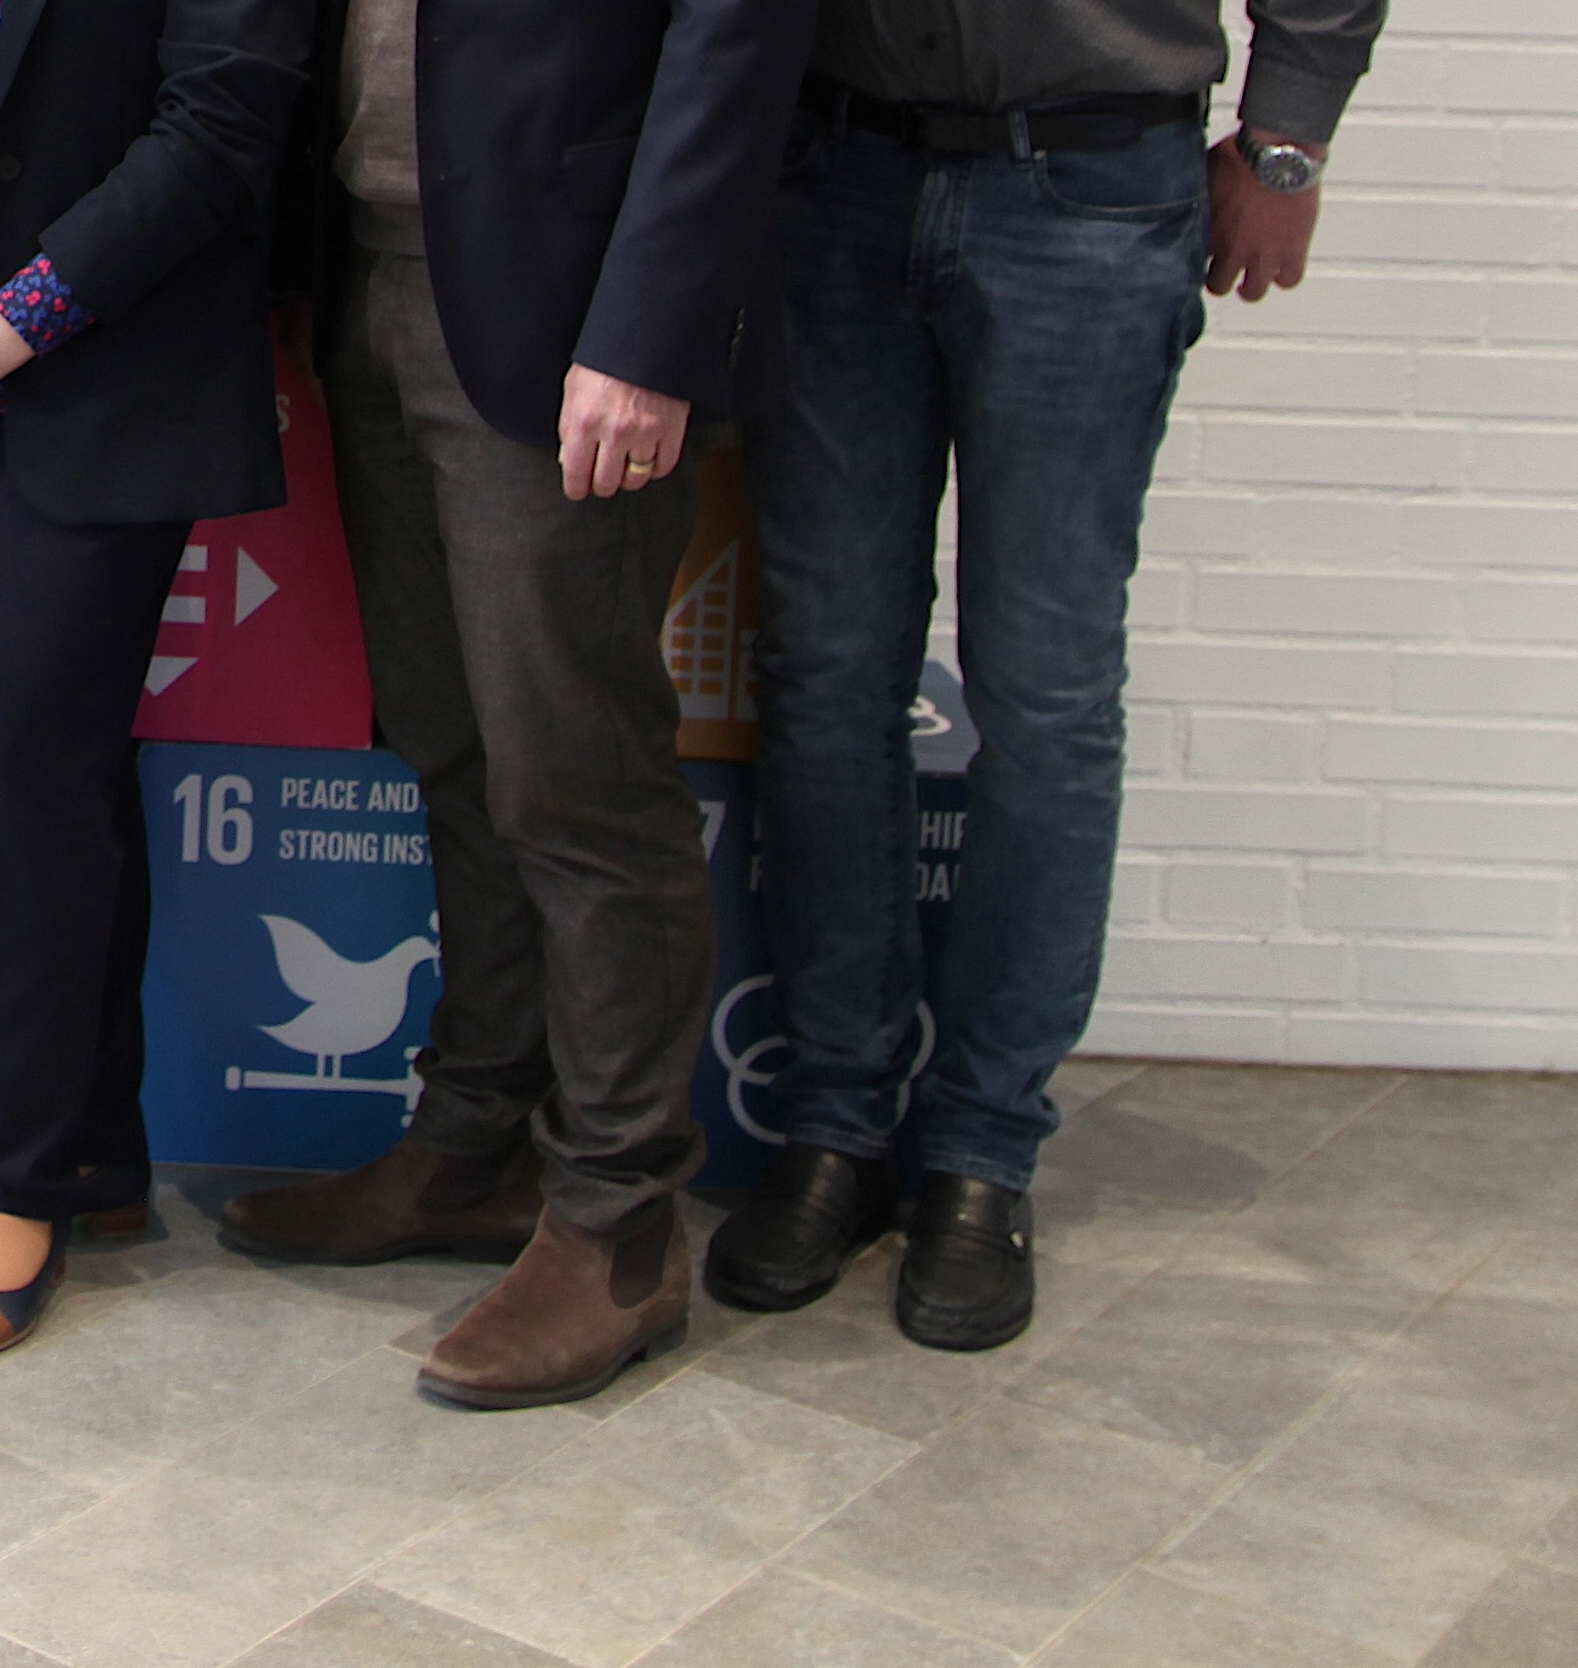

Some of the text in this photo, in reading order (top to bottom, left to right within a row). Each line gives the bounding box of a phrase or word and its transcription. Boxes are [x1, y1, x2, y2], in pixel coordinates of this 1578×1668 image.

[280, 778, 421, 813] PEACE AND
[172, 773, 254, 865] 16
[278, 828, 379, 863] STRONG
